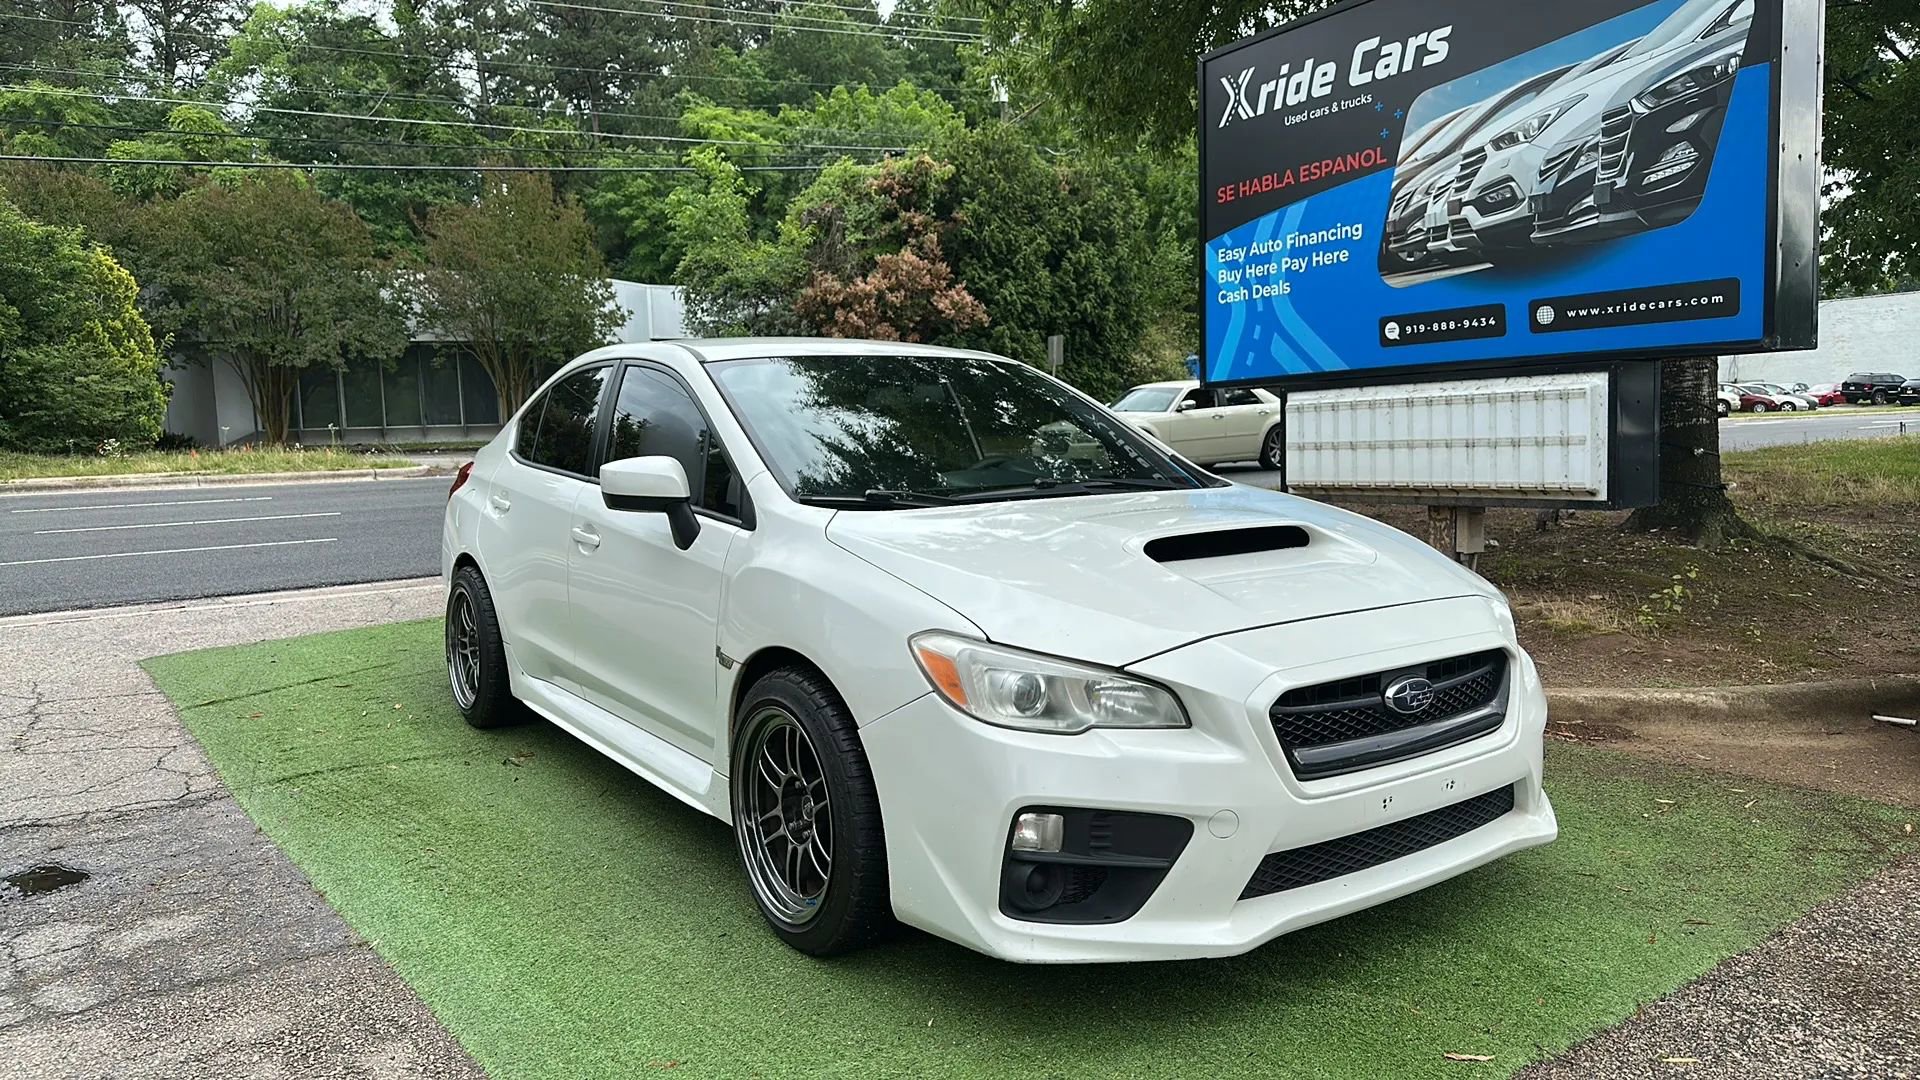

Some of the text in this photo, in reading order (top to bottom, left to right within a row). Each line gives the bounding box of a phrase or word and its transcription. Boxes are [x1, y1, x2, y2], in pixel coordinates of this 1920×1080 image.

[1219, 25, 1453, 128] Xride Cars
[1284, 94, 1373, 126] Used cars & trucks
[1217, 147, 1388, 203] SE HABLA ESPANOL
[1218, 223, 1363, 263] Easy Auto Financing
[1218, 249, 1349, 284] Buy Here Pay Here
[1218, 280, 1291, 304] Cash Deals
[1566, 294, 1724, 318] www.xridecars.com
[1405, 316, 1496, 335] 919-888-9434
